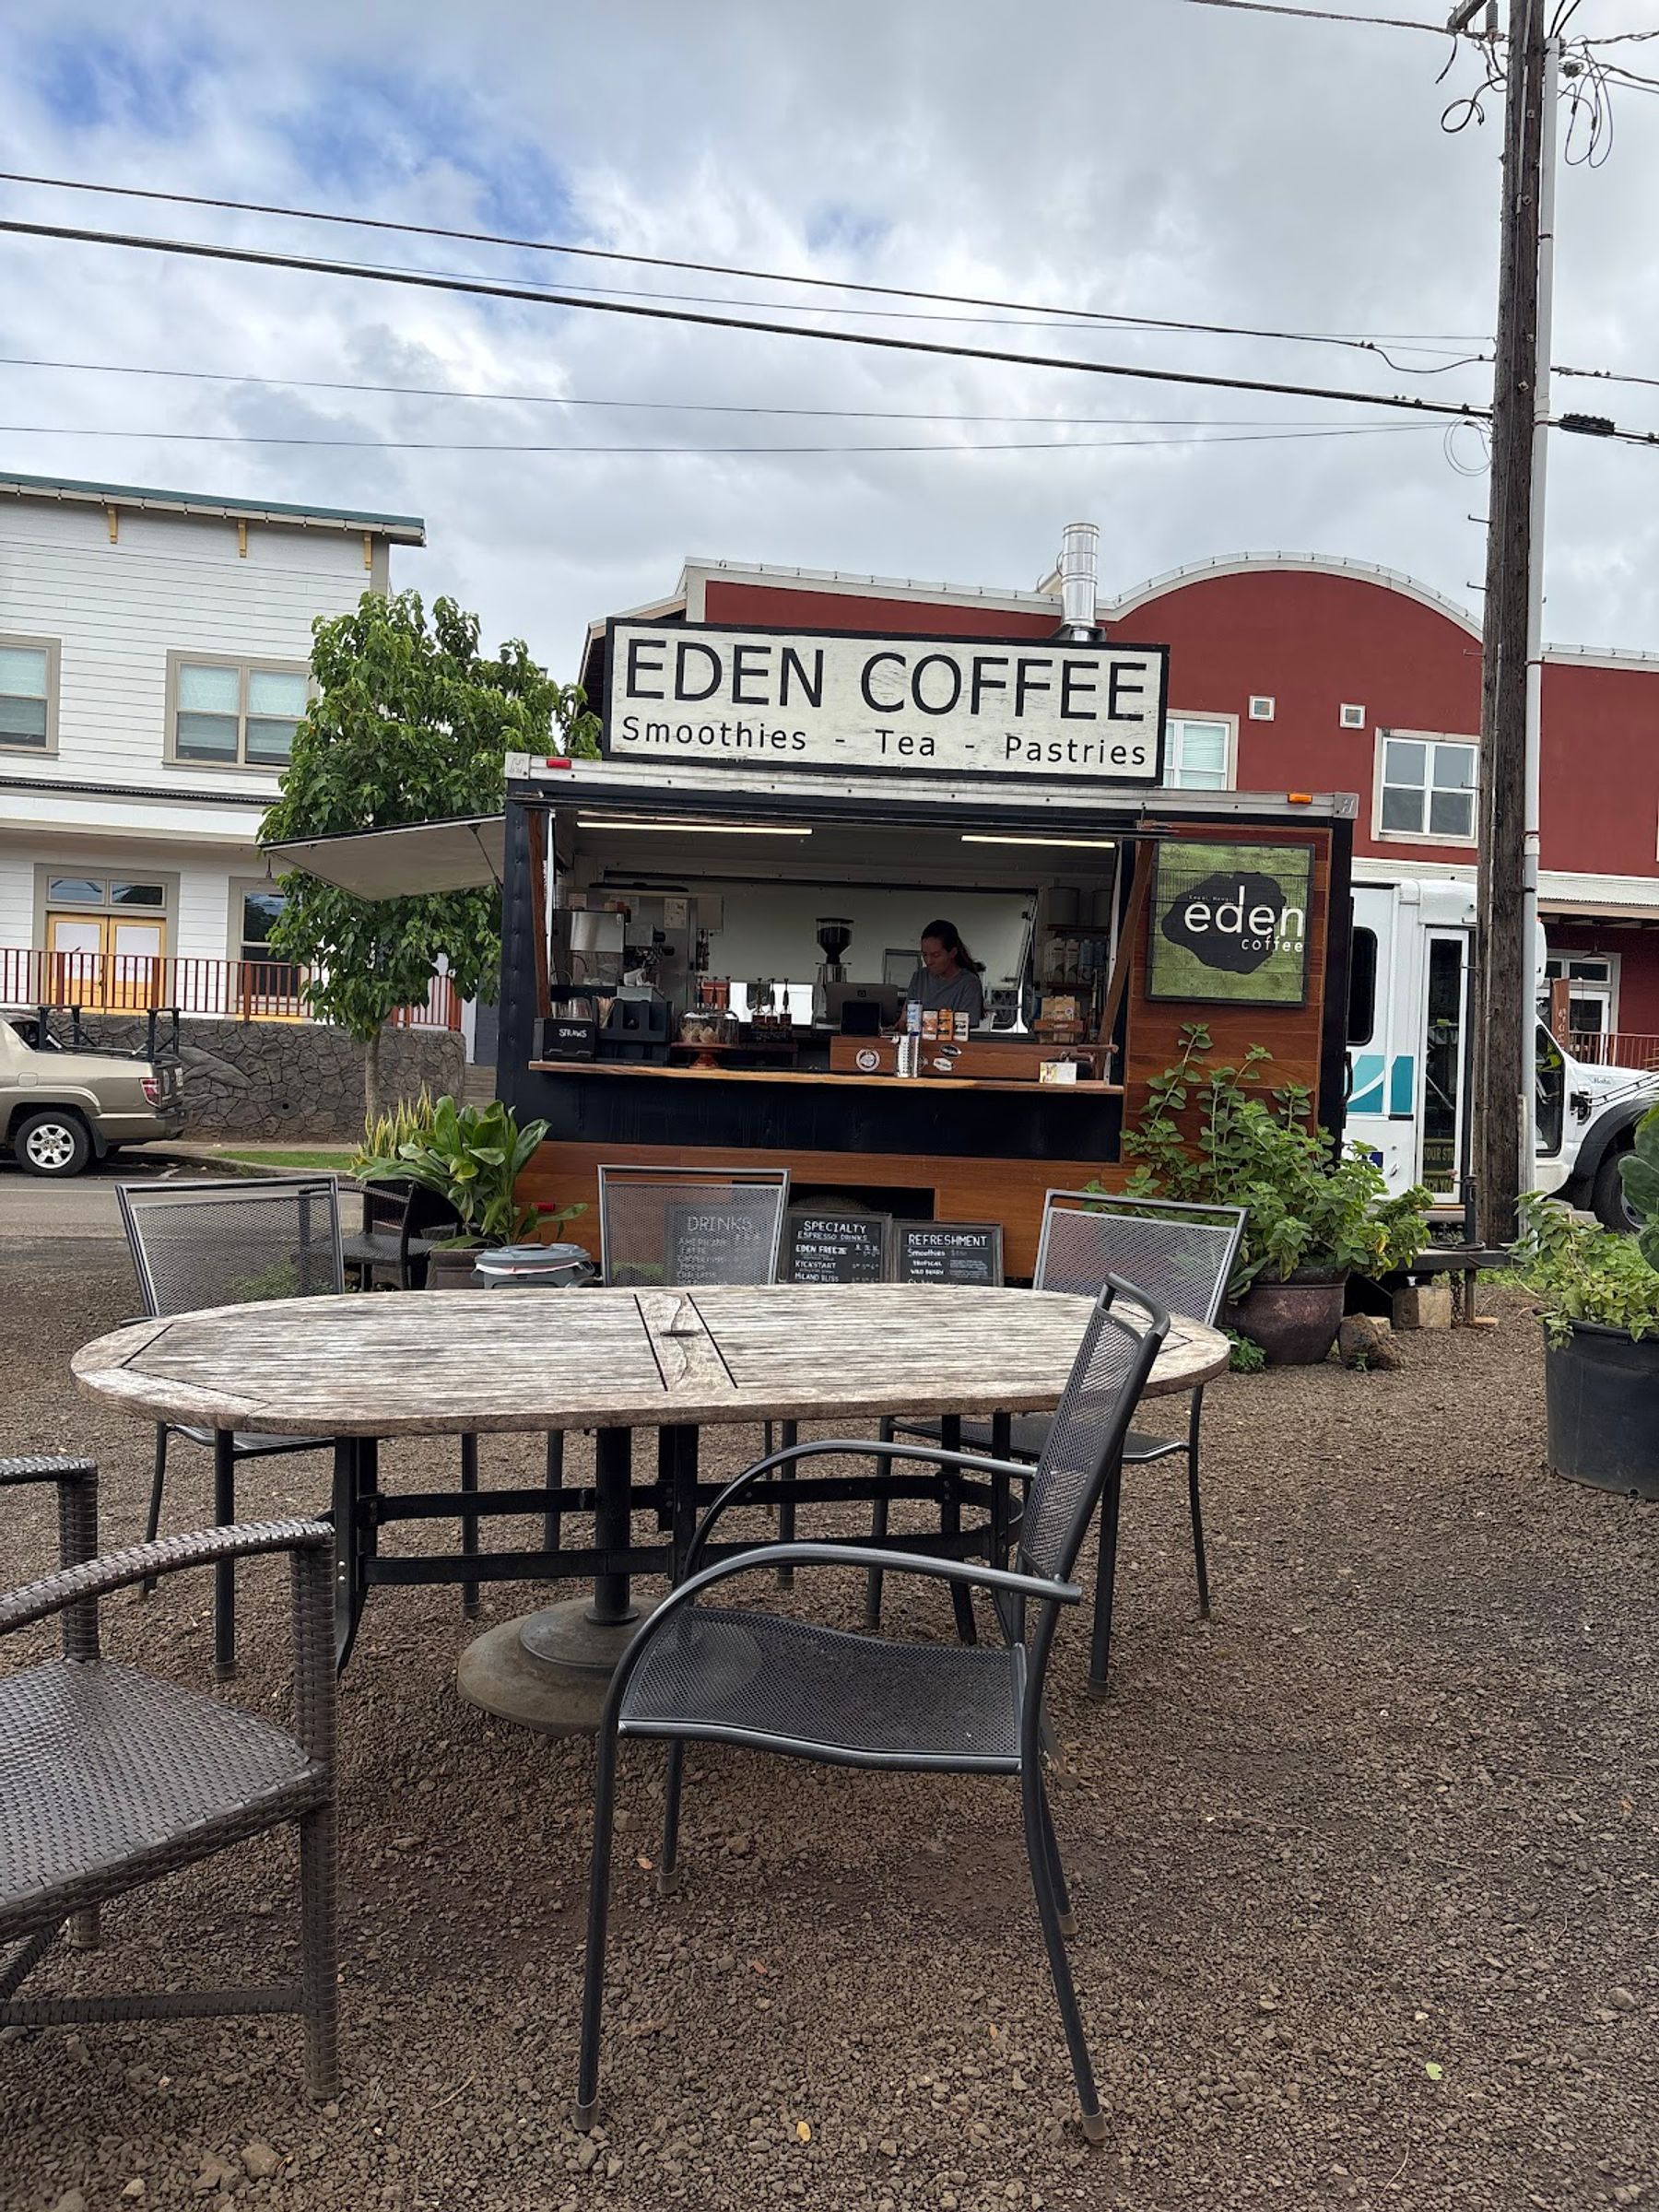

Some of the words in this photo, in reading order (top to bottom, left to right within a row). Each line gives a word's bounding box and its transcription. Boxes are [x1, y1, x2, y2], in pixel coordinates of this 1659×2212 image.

[626, 638, 824, 708] EDEN
[861, 652, 1147, 722] COFFEE
[622, 715, 806, 751] Smoothies
[875, 728, 935, 757] Tea
[1006, 735, 1146, 766] Pastries
[1184, 885, 1304, 937] eden
[1241, 935, 1303, 953] coffee
[559, 1028, 588, 1039] STRAWS
[688, 1216, 753, 1231] DRINKS
[804, 1220, 866, 1234] SPECIALTY
[797, 1230, 838, 1241] ESPRESSO
[908, 1233, 988, 1247] REFRESHMENT
[795, 1244, 817, 1253] EDEN
[794, 1260, 837, 1269] KICKSTART
[794, 1272, 819, 1281] ISLAND
